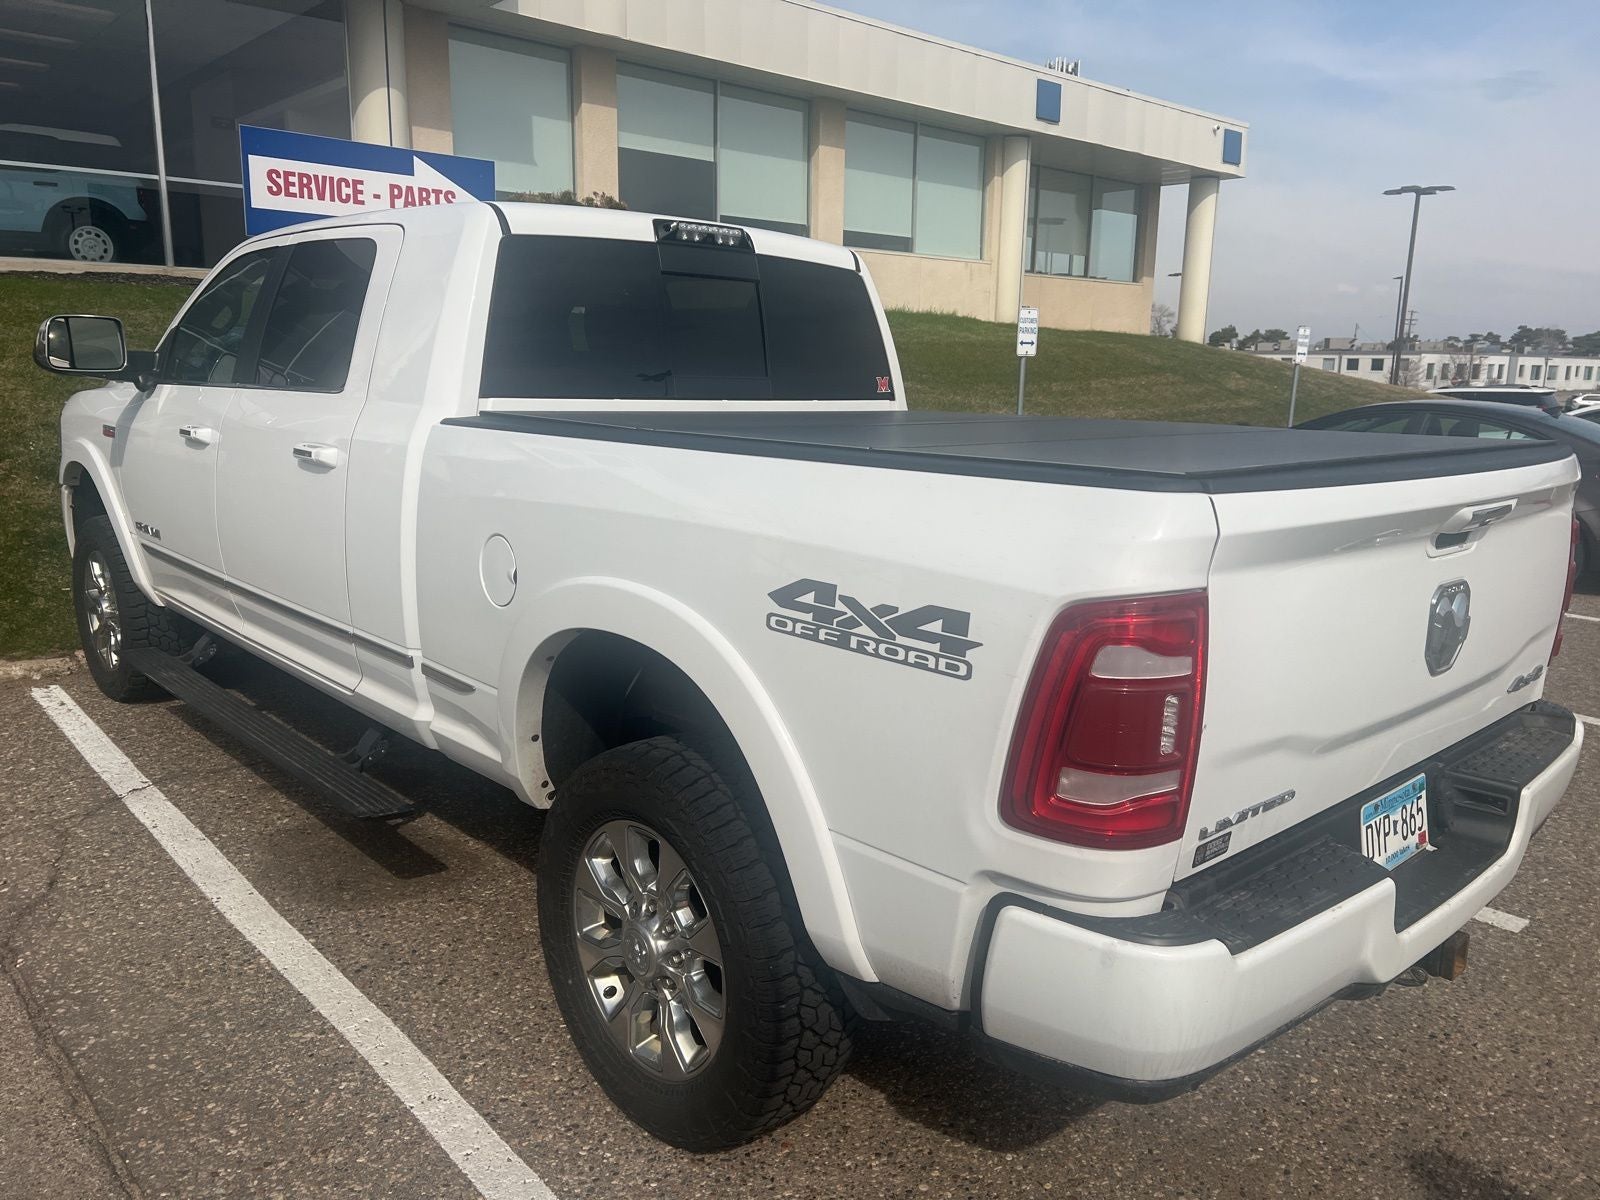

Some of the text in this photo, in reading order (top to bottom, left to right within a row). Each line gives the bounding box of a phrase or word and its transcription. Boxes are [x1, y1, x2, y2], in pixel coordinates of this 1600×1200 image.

[266, 168, 365, 206] SERVICE
[1019, 326, 1037, 335] PARKING
[769, 616, 968, 676] OFF ROAD
[1365, 794, 1424, 860] DYP 865
